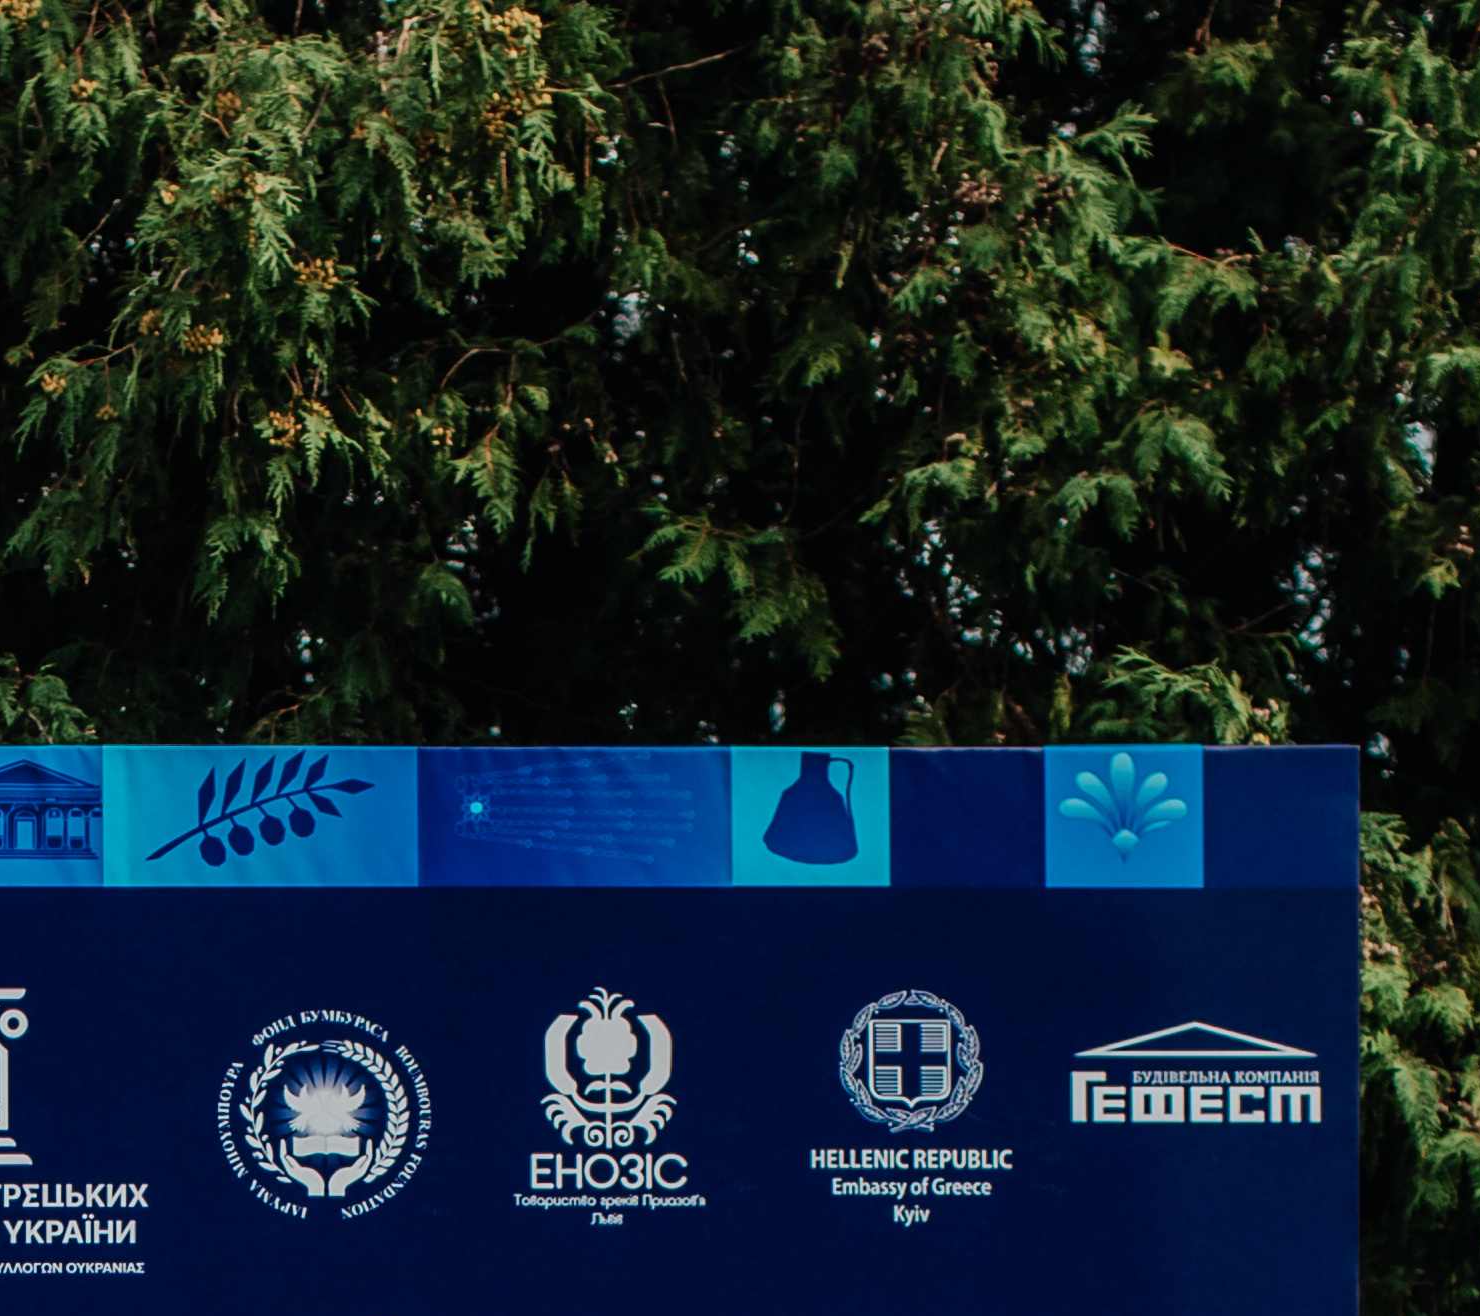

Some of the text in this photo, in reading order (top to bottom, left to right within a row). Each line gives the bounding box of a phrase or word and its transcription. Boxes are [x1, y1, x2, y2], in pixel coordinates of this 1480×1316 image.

[252, 1009, 389, 1046] ФОНД БУМБУРАСА
[1132, 1071, 1320, 1085] БУДІВЕЛЬНА КОМПАНІЯ
[341, 1045, 432, 1219] BOUMBOURAS FOUNDATION
[810, 1149, 1013, 1169] HELLENIC REPUBLIC
[530, 1153, 688, 1189] ЕНОЗІС
[832, 1176, 992, 1200] Embassy of Greece
[513, 1193, 596, 1210] Товариство
[600, 1193, 639, 1210] греків
[590, 1212, 623, 1226] Львів
[893, 1204, 930, 1227] Kyiv
[3, 1213, 137, 1244] УКРАЇНИ
